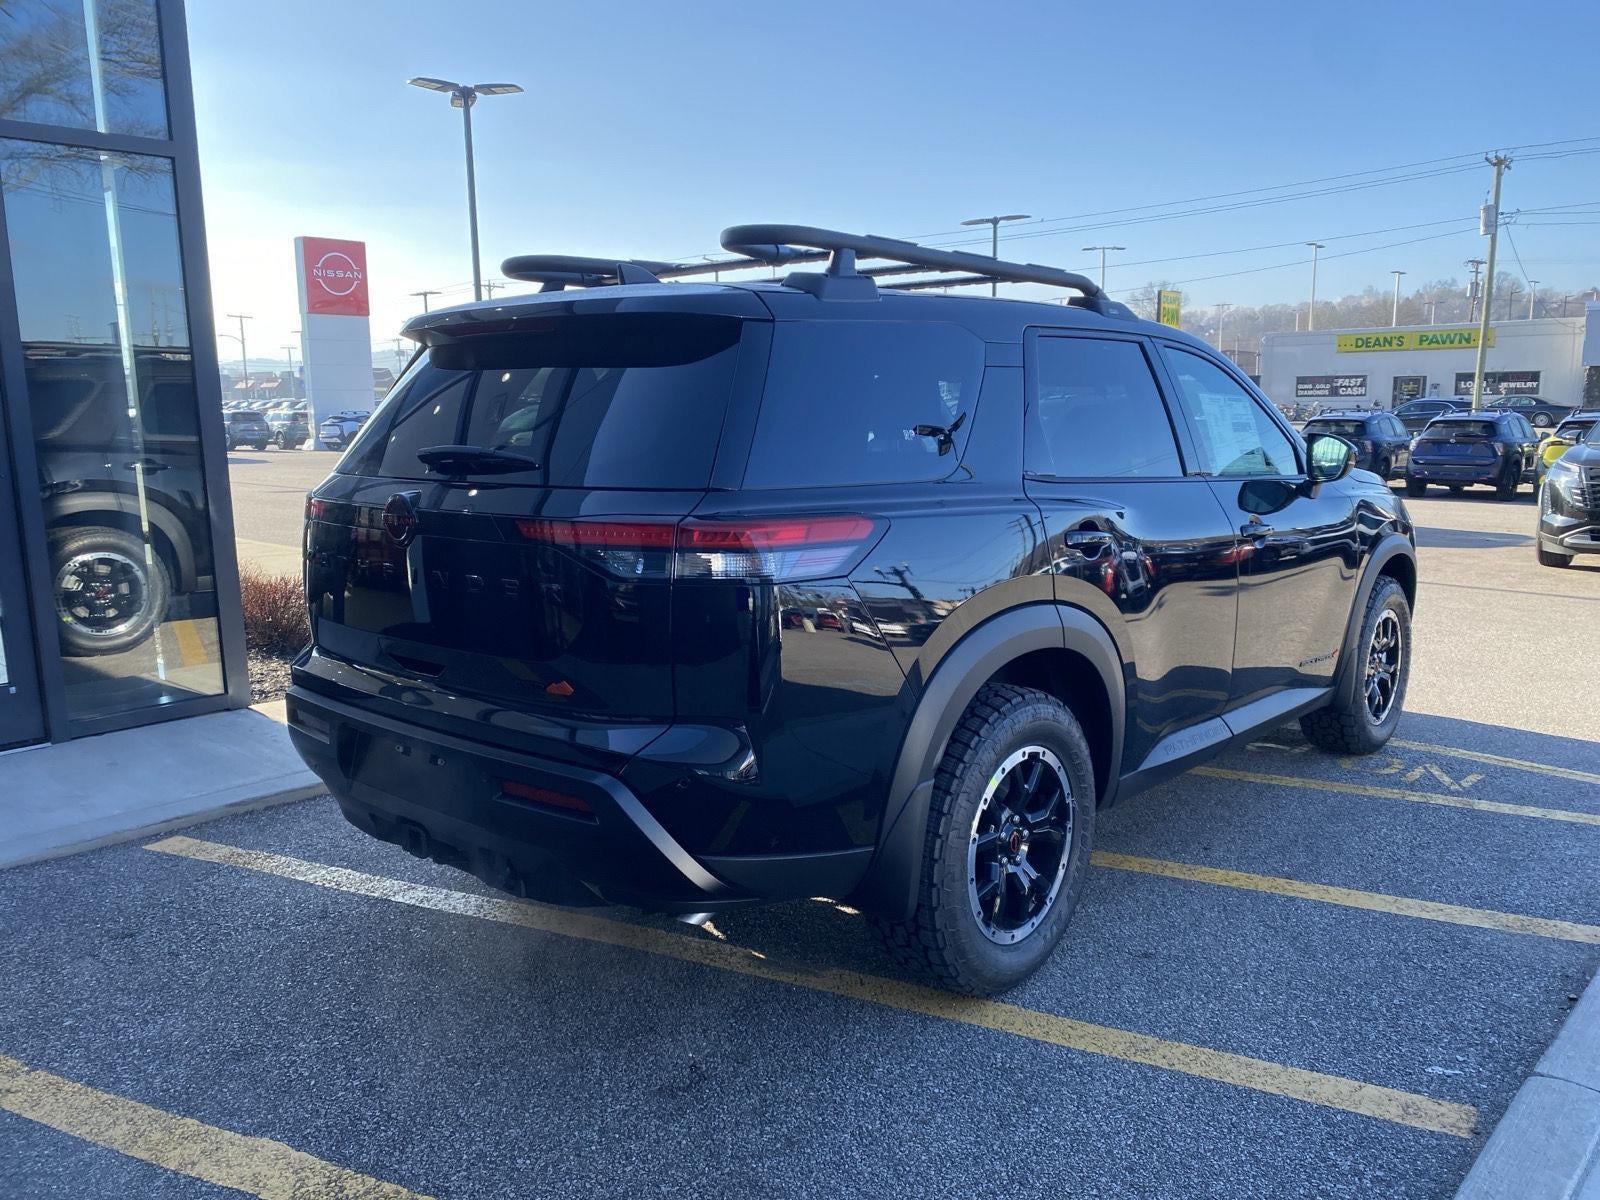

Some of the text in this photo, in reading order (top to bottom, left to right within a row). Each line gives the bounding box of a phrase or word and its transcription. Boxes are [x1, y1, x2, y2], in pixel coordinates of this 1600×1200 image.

[313, 268, 362, 280] NISSAN
[1337, 378, 1364, 387] FAST
[1461, 380, 1487, 388] LON
[1339, 386, 1366, 395] CASH
